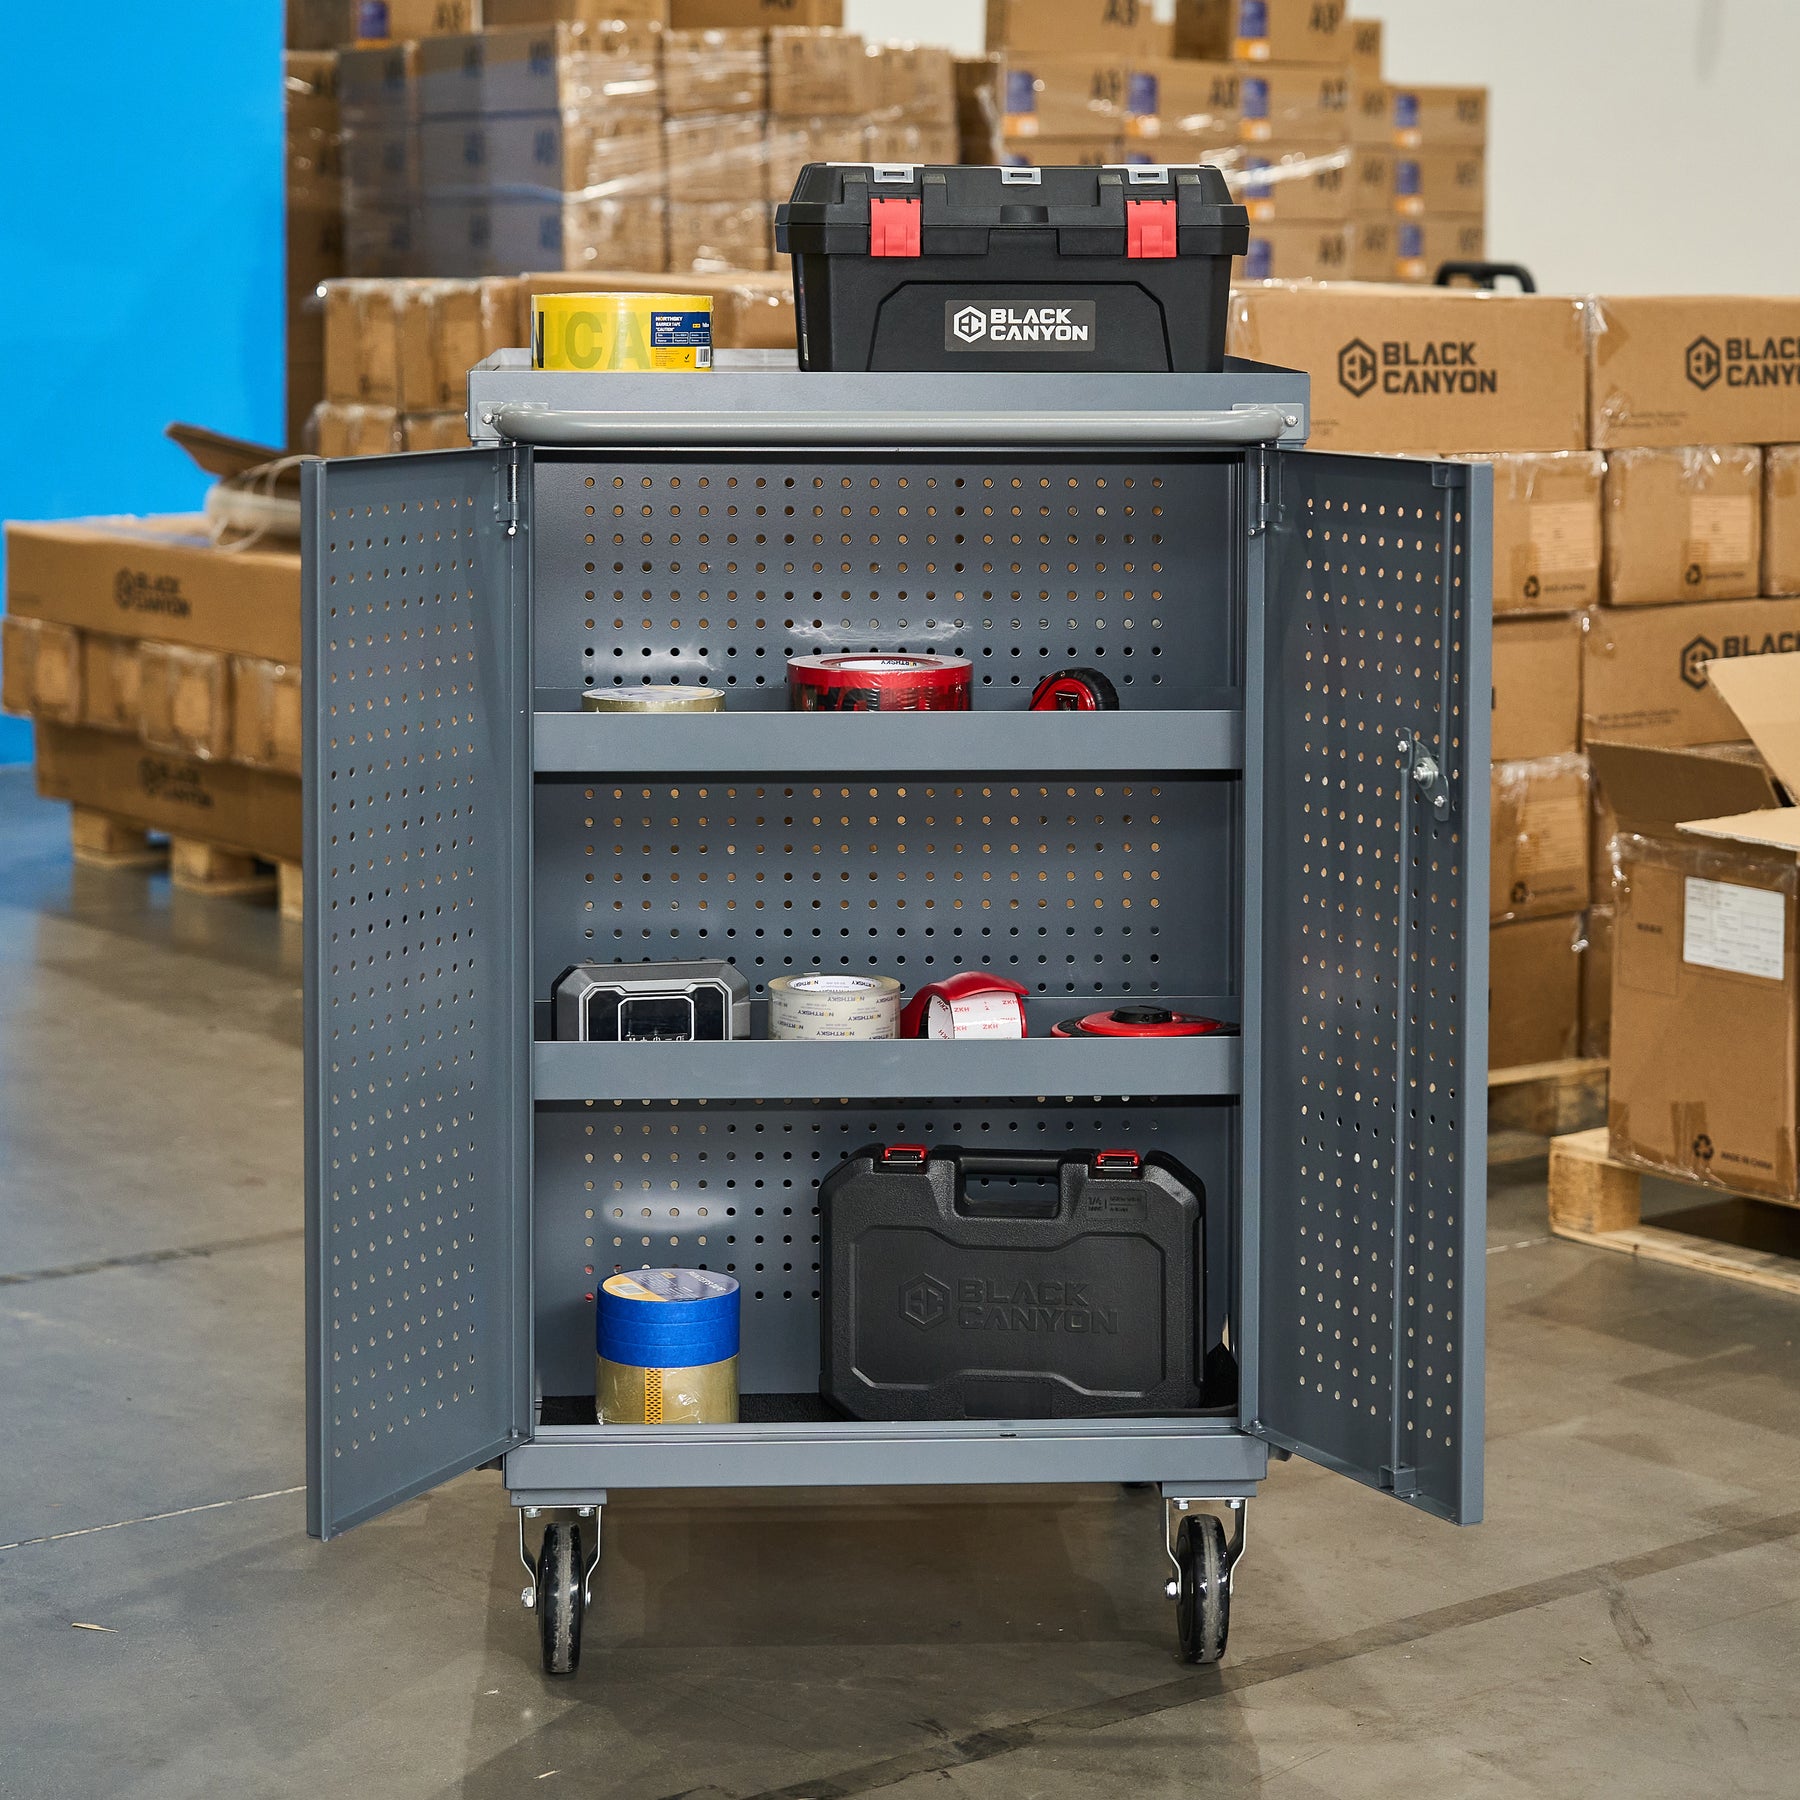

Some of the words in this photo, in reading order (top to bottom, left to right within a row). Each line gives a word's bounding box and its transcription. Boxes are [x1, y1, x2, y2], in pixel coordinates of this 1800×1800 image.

[990, 308, 1072, 324] BLACK
[990, 325, 1088, 341] CANYON
[1383, 342, 1476, 365] BLACK
[1383, 370, 1497, 393] CANYON
[957, 1278, 1090, 1306] BLACK
[957, 1306, 1119, 1335] CANYON
